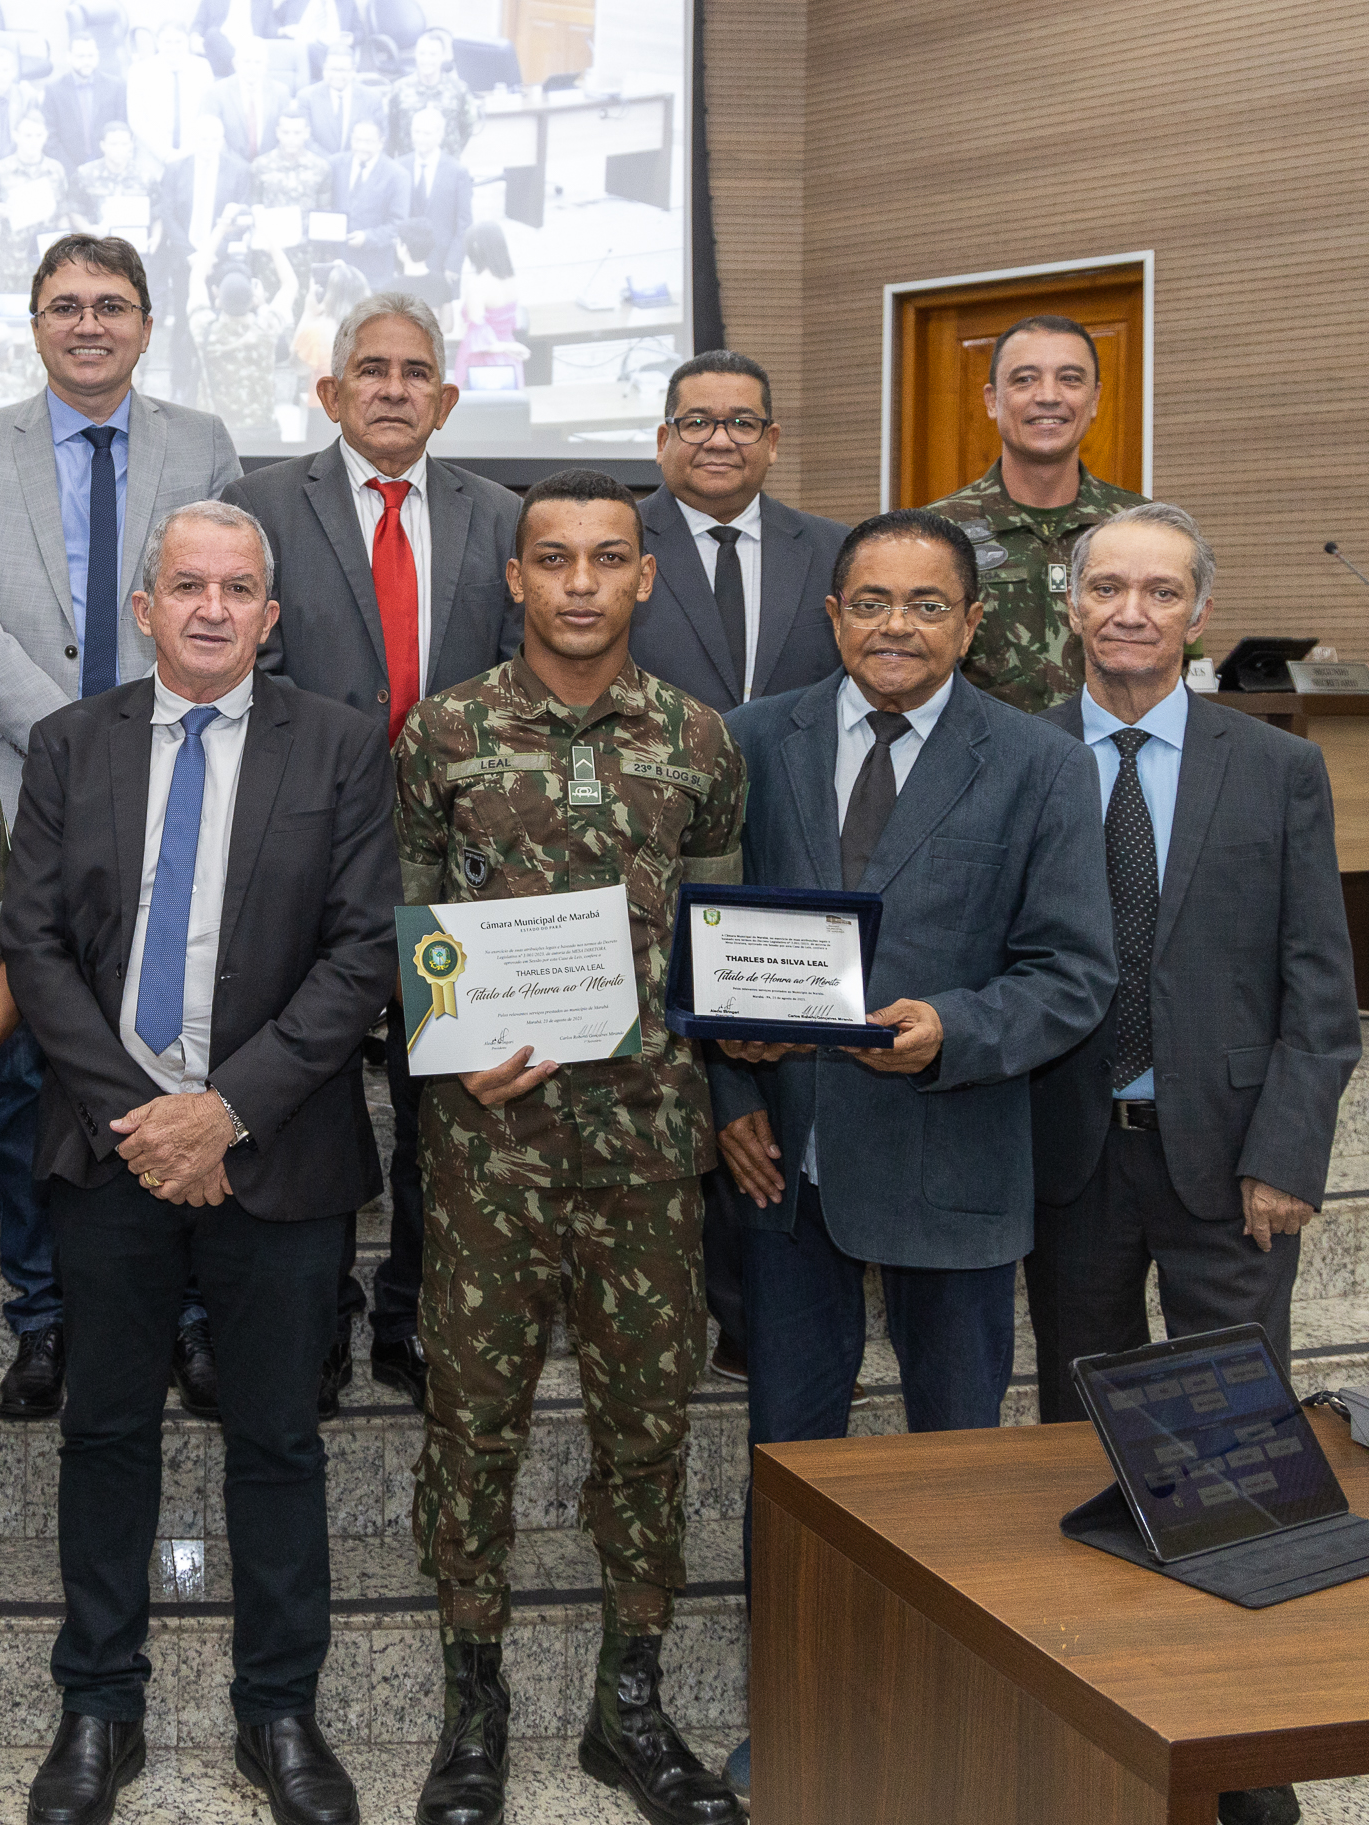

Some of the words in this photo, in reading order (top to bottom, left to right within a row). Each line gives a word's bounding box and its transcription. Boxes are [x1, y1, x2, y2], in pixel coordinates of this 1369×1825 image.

[480, 758, 512, 770] LEAL
[655, 765, 664, 779] B
[666, 768, 689, 783] LOG
[690, 774, 702, 787] SL
[480, 921, 513, 930] Câmara
[514, 915, 556, 927] Municipal
[556, 914, 568, 923] de
[569, 909, 600, 921] Marabá
[515, 967, 551, 977] THARLES
[551, 967, 564, 975] DA
[564, 965, 586, 974] SILVA
[586, 963, 606, 972] LEAL
[725, 955, 765, 964] THARLES
[766, 957, 779, 965] DA
[780, 958, 806, 966] SILVA
[807, 960, 829, 968] LEAL
[713, 968, 745, 983] Título
[745, 971, 759, 983] de
[760, 972, 792, 984] Honra
[805, 975, 840, 988] Mérito
[466, 987, 500, 1004] Título
[501, 985, 516, 999] de
[518, 982, 560, 999] Honra
[562, 984, 578, 993] ao
[579, 973, 624, 992] Mérito
